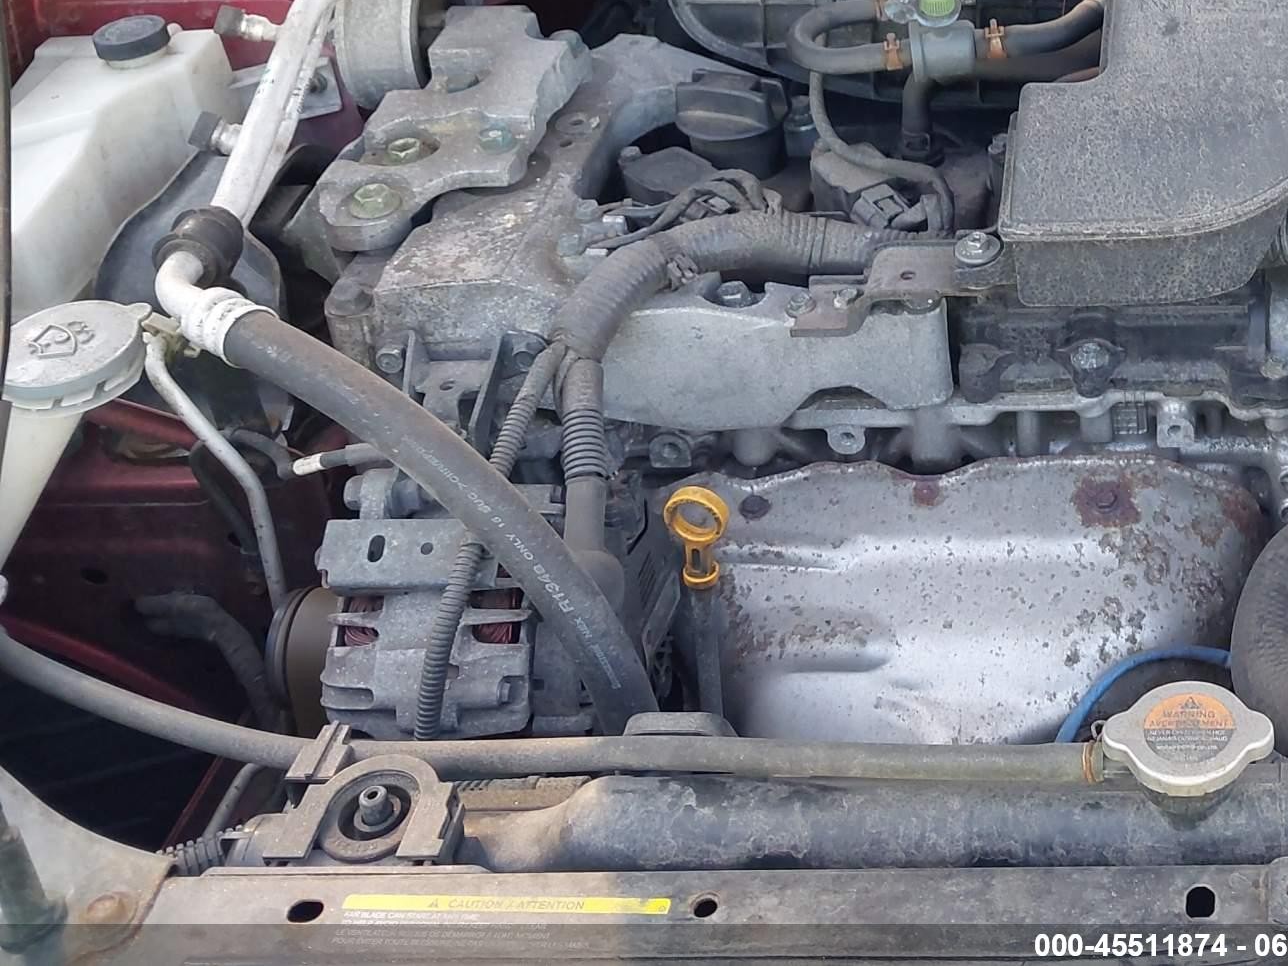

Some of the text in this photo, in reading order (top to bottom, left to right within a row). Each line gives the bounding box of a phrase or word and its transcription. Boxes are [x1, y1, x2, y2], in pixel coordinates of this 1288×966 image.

[505, 533, 534, 561] ONLY
[1163, 710, 1216, 718] WARNING
[448, 898, 502, 909] CAUTION
[515, 899, 584, 910] ATTENTION
